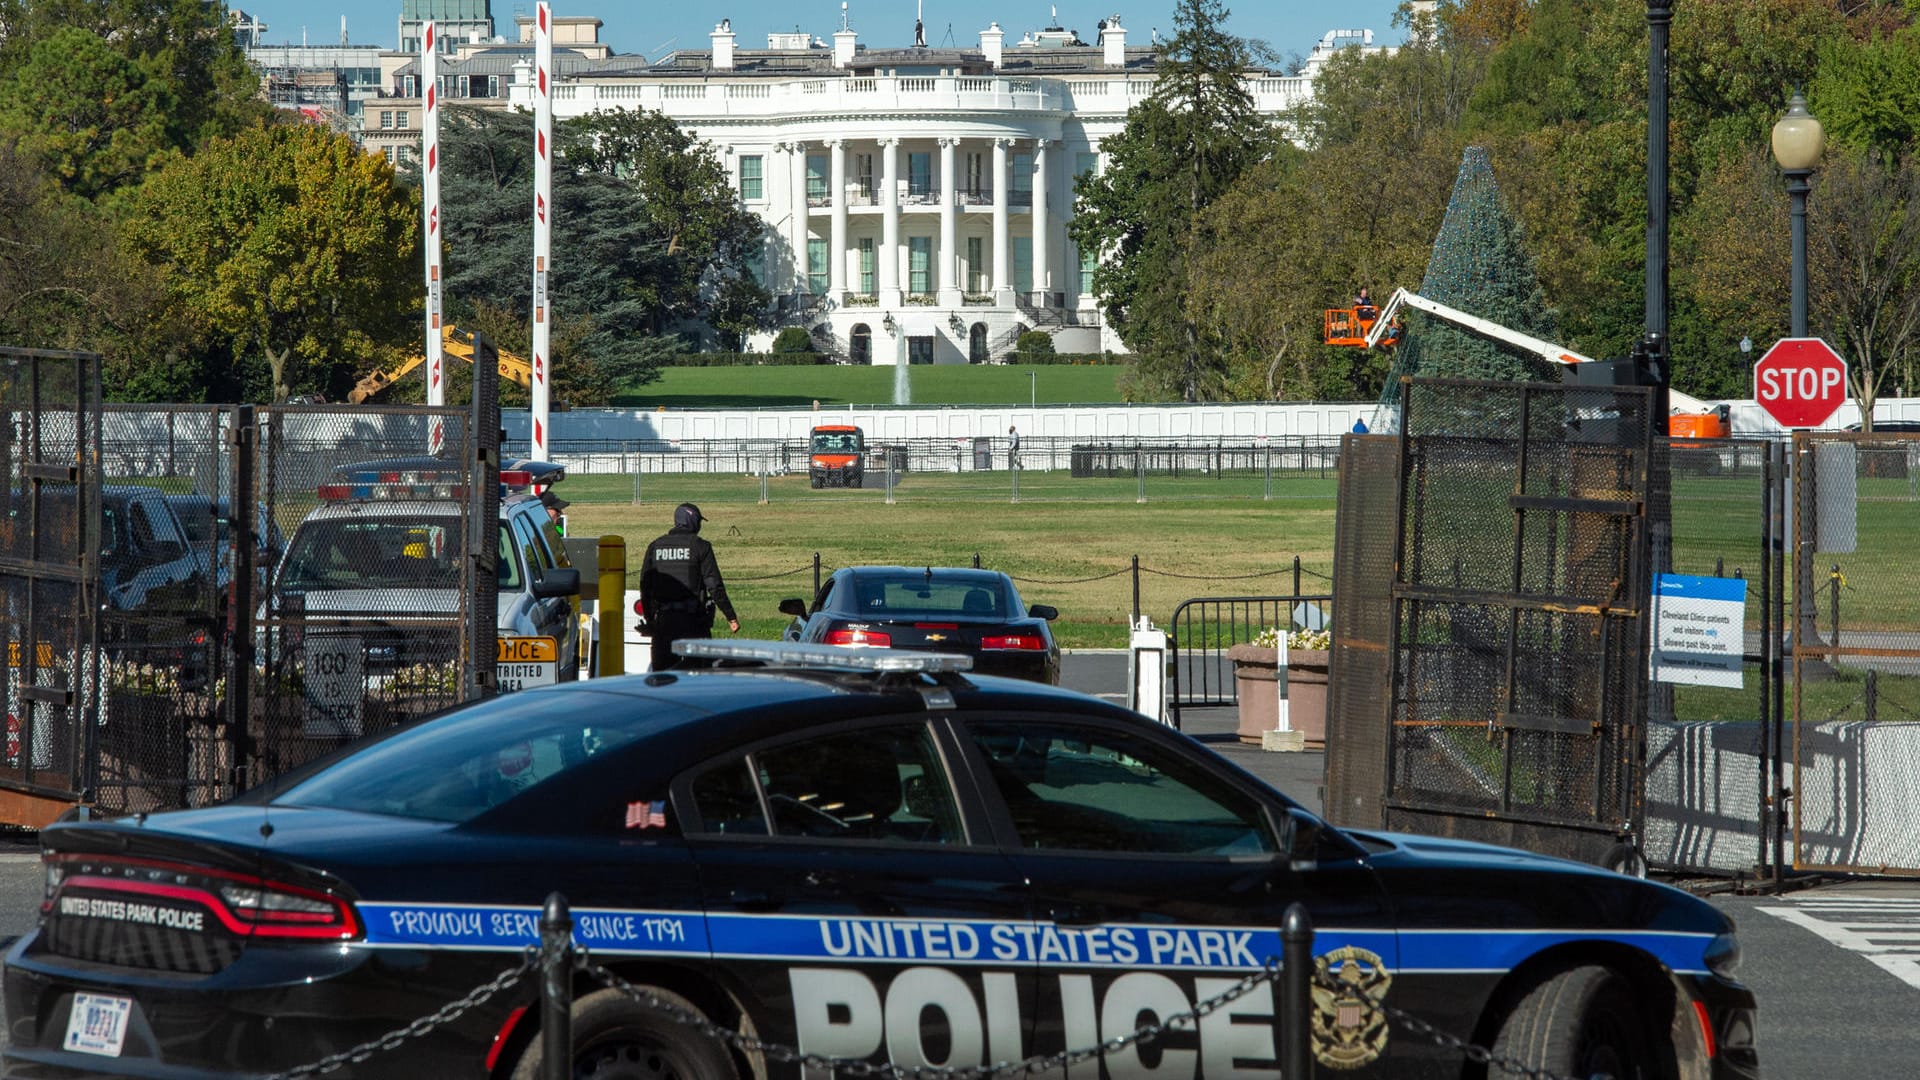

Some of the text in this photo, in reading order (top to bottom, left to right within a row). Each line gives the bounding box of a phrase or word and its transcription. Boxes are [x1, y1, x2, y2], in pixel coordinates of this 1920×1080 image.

[1761, 367, 1841, 400] STOP
[655, 548, 690, 560] POLICE
[1661, 610, 1730, 624] Cleveland Clinic patients
[1673, 626, 1683, 634] and
[1684, 626, 1704, 636] visitors
[496, 641, 541, 660] TICE
[61, 896, 204, 931] UNITED STATES PARK POLICE
[390, 911, 483, 937] PROUDLY
[580, 915, 639, 940] SINCE
[642, 918, 685, 942] 1791
[819, 919, 1260, 967] UNITED STATES PARK
[788, 966, 1283, 1080] POLICE
